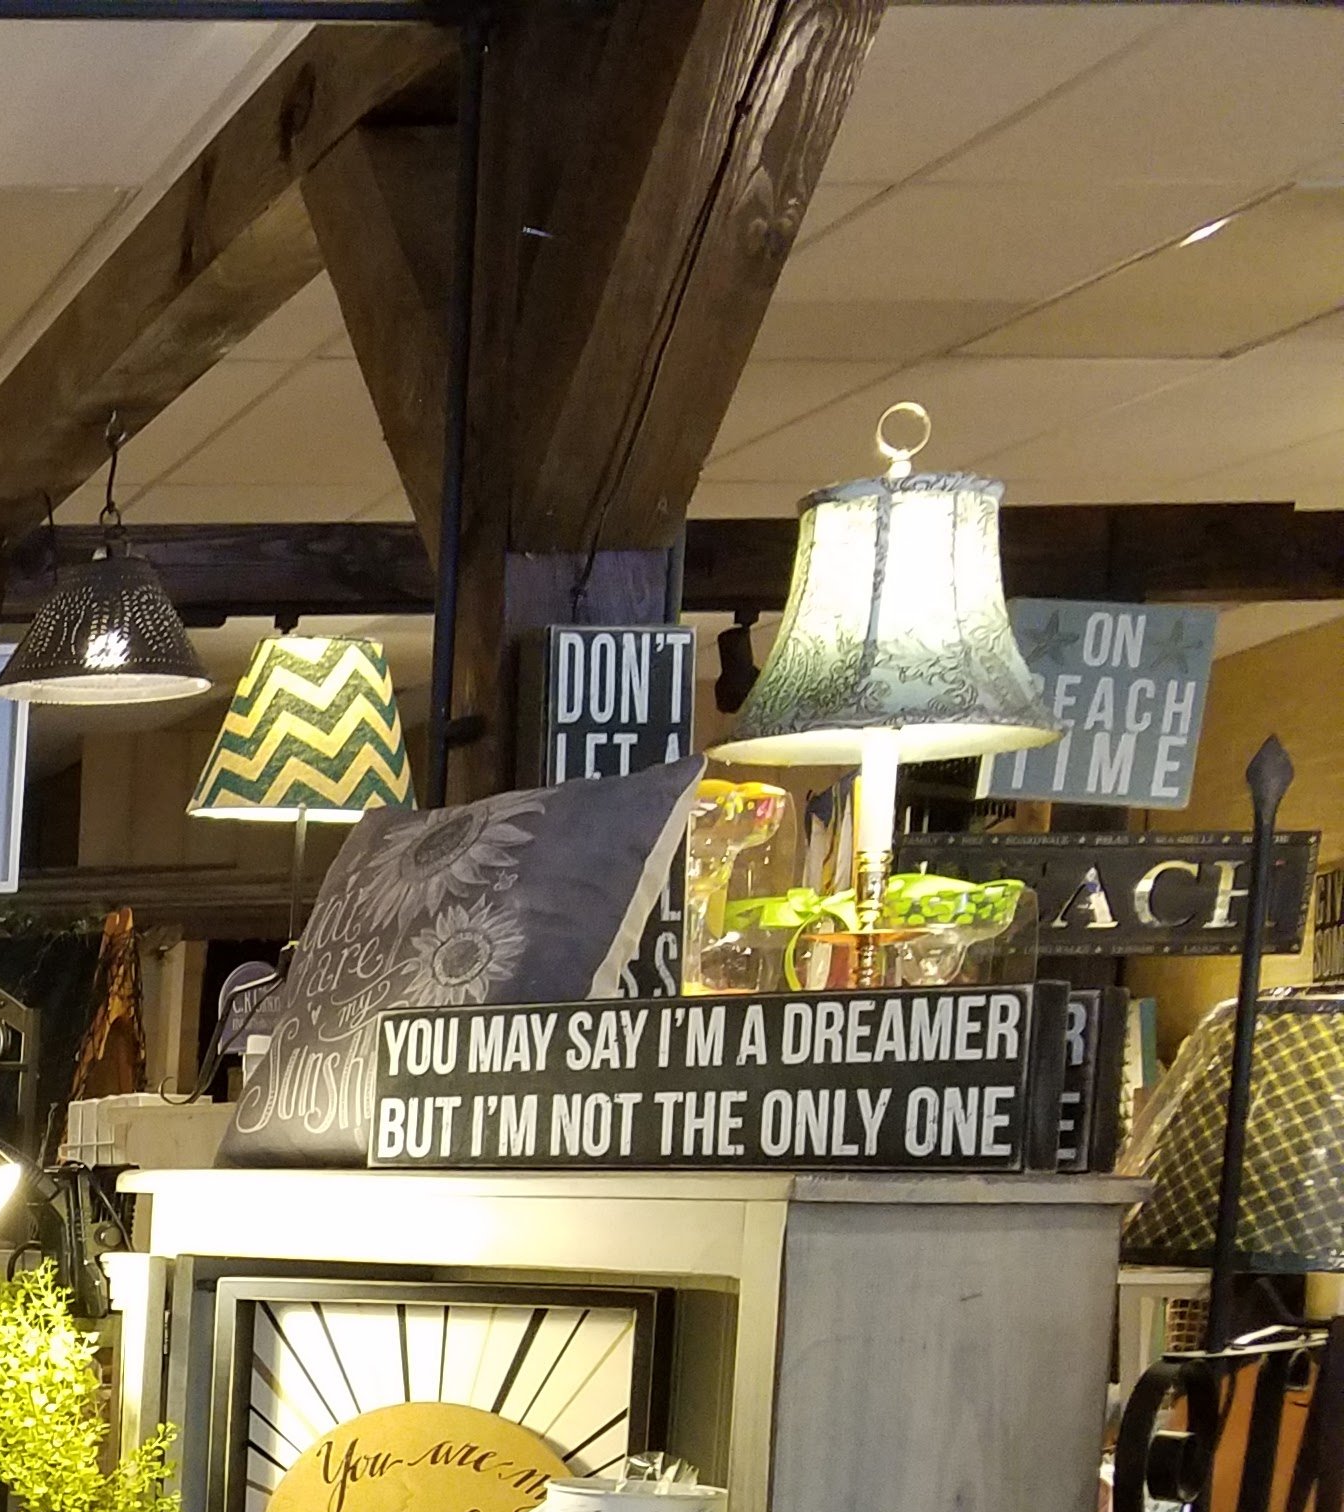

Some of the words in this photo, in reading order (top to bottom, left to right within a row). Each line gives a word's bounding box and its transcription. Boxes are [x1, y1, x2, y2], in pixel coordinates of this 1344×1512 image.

[1083, 612, 1144, 668] ON
[557, 632, 691, 725] DON'T
[1050, 860, 1277, 929] ACH
[384, 1019, 457, 1076] YOU
[468, 1016, 558, 1074] MAY
[565, 1010, 648, 1070] SAY
[658, 1007, 725, 1068] I'M
[736, 1005, 768, 1065] A
[782, 994, 1021, 1065] DREAMER
[378, 1098, 470, 1158] BUT
[474, 1096, 538, 1157] I'M
[550, 1094, 642, 1156] NOT
[654, 1092, 746, 1155] THE
[761, 1089, 895, 1156] ONLY
[907, 1087, 1016, 1156] ONE
[408, 1440, 506, 1474] are
